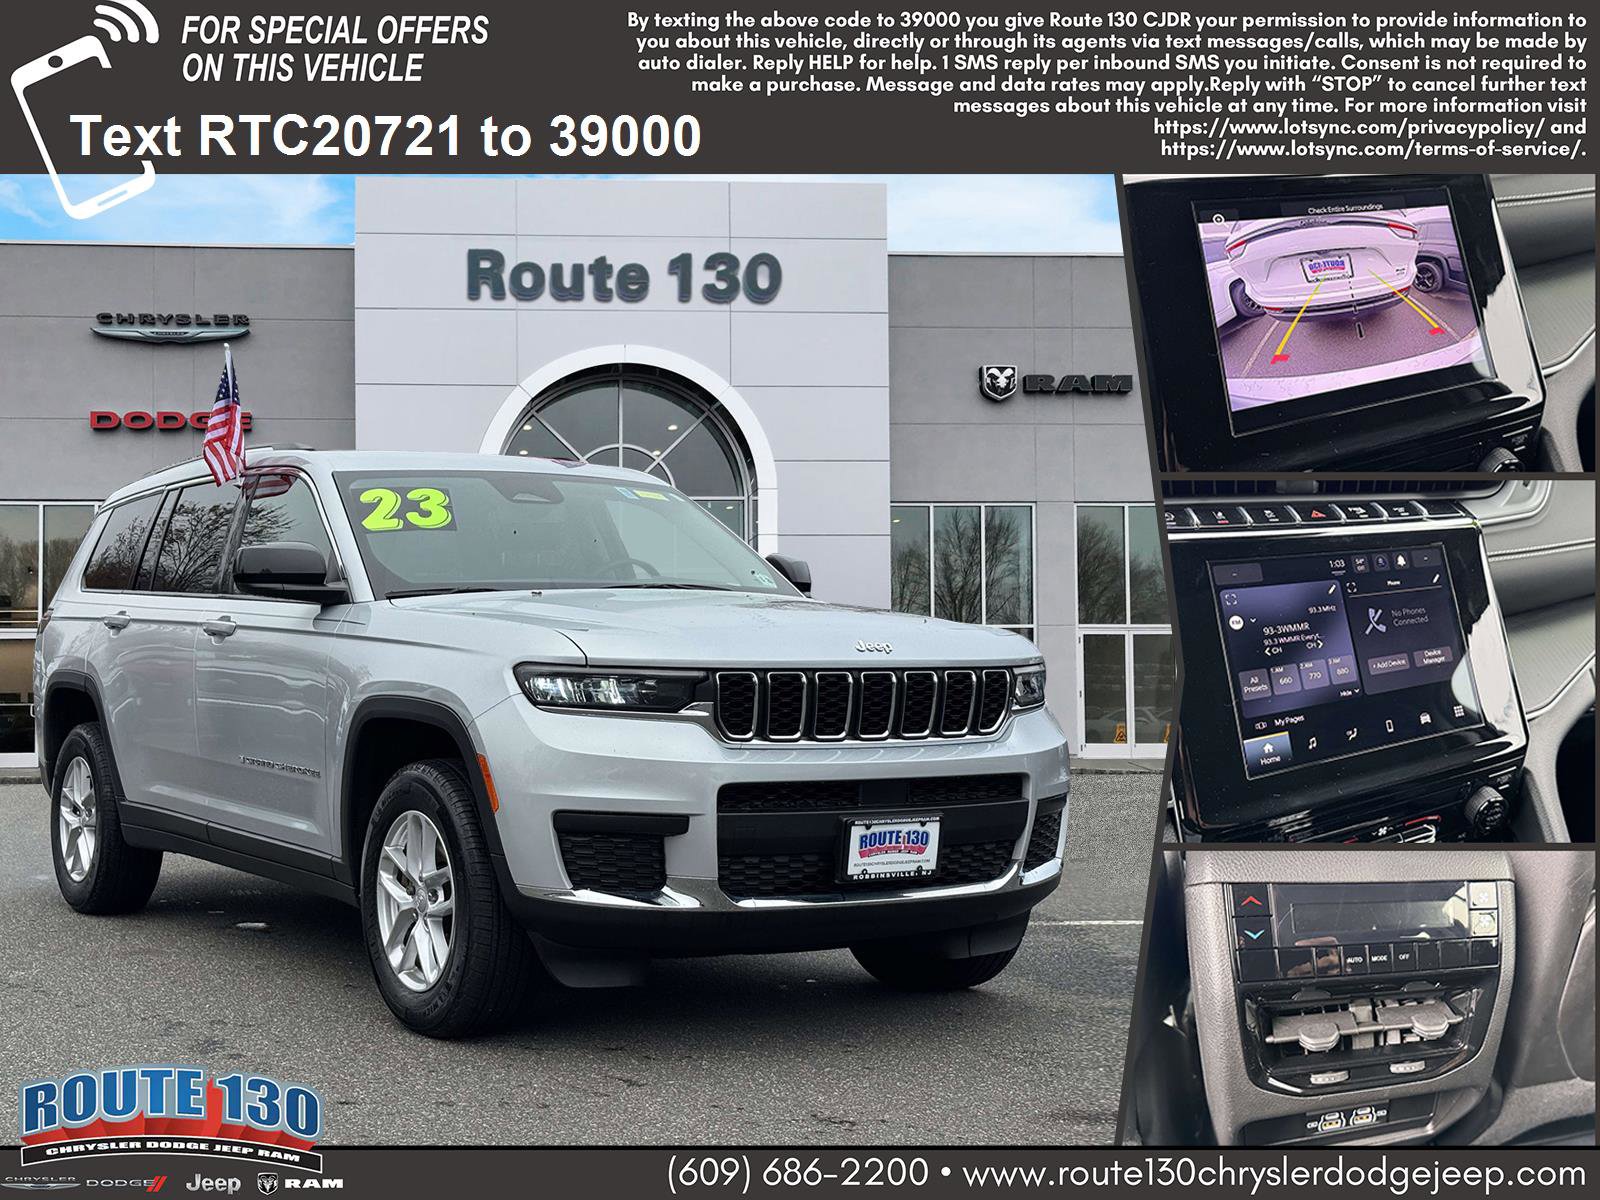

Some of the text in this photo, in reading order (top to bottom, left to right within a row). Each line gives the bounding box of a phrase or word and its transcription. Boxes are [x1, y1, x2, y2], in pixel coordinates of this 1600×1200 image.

[1308, 206, 1327, 214] Check
[1345, 203, 1384, 211] Surroundings
[466, 248, 783, 304] Route 130
[95, 312, 250, 327] CHRYSLER
[1022, 374, 1134, 395] RAM
[359, 487, 452, 532] 23
[1329, 559, 1346, 568] 1:03
[1391, 607, 1427, 618] No Phones
[1392, 615, 1430, 627] Connected
[854, 639, 894, 655] Jeep
[1424, 649, 1442, 657] Device
[1389, 658, 1406, 667] Device
[1309, 671, 1322, 680] 770
[1243, 684, 1269, 694] Presets
[1274, 715, 1305, 727] My Pages
[1260, 756, 1281, 766] Home
[859, 830, 930, 850] ROUTE 130
[1346, 956, 1364, 964] AUTO
[1371, 954, 1388, 962] MODE
[1398, 953, 1410, 961] OFF
